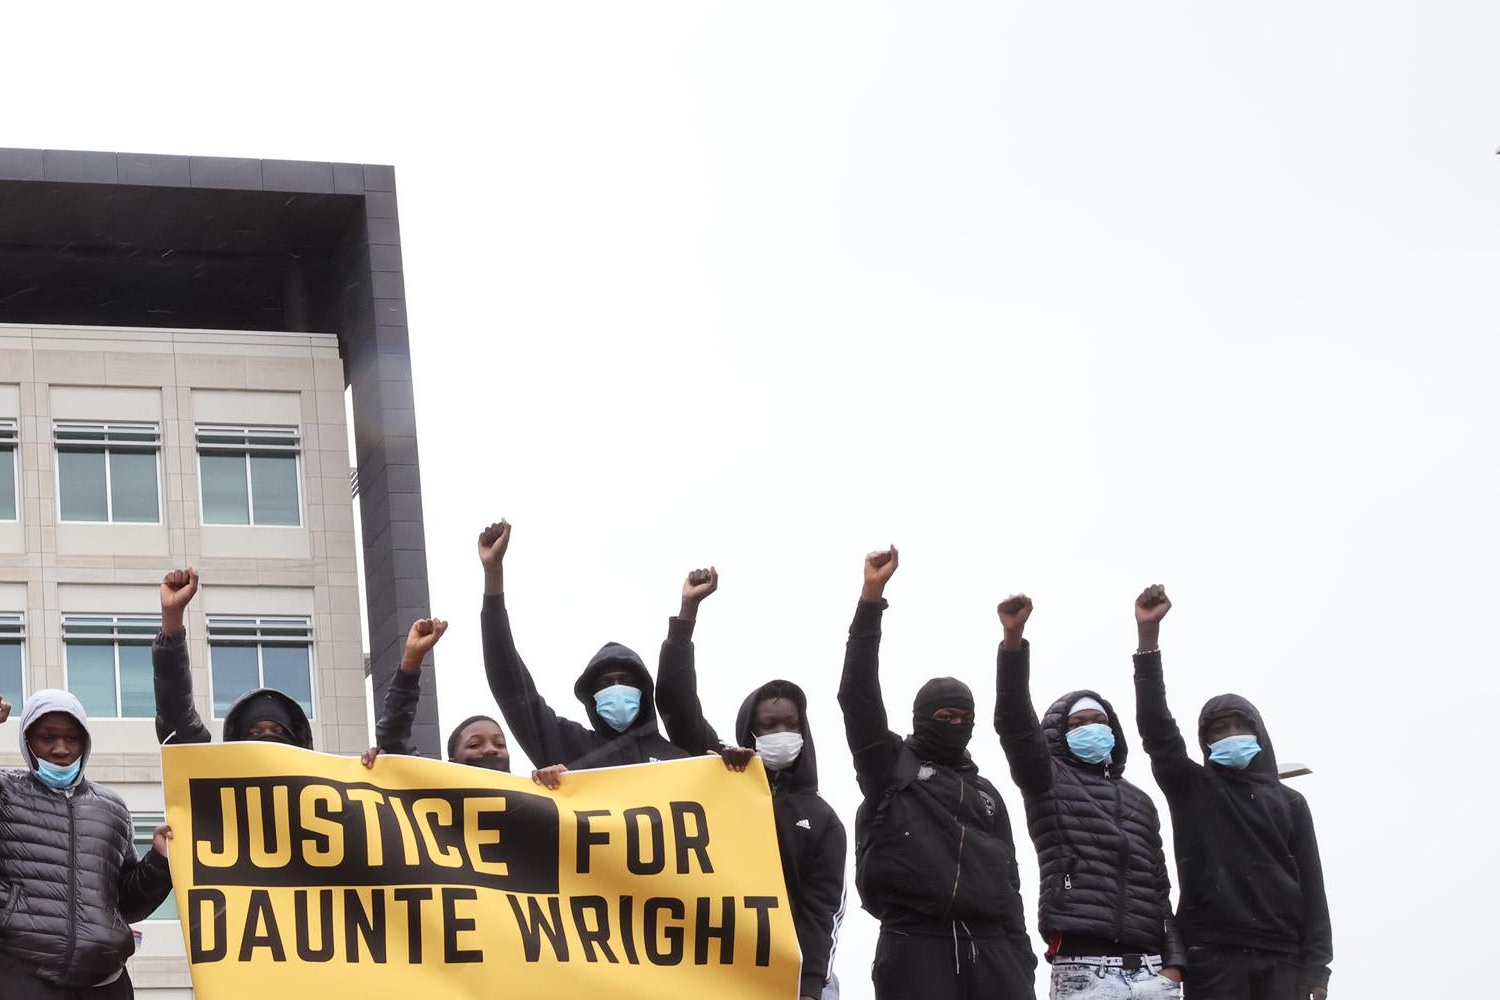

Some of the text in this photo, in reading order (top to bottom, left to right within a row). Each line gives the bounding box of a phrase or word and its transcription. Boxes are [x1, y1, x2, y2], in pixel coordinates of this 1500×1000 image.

[196, 785, 715, 876] JUSTICE FOR
[187, 888, 779, 967] DAUNTE WRIGHT
